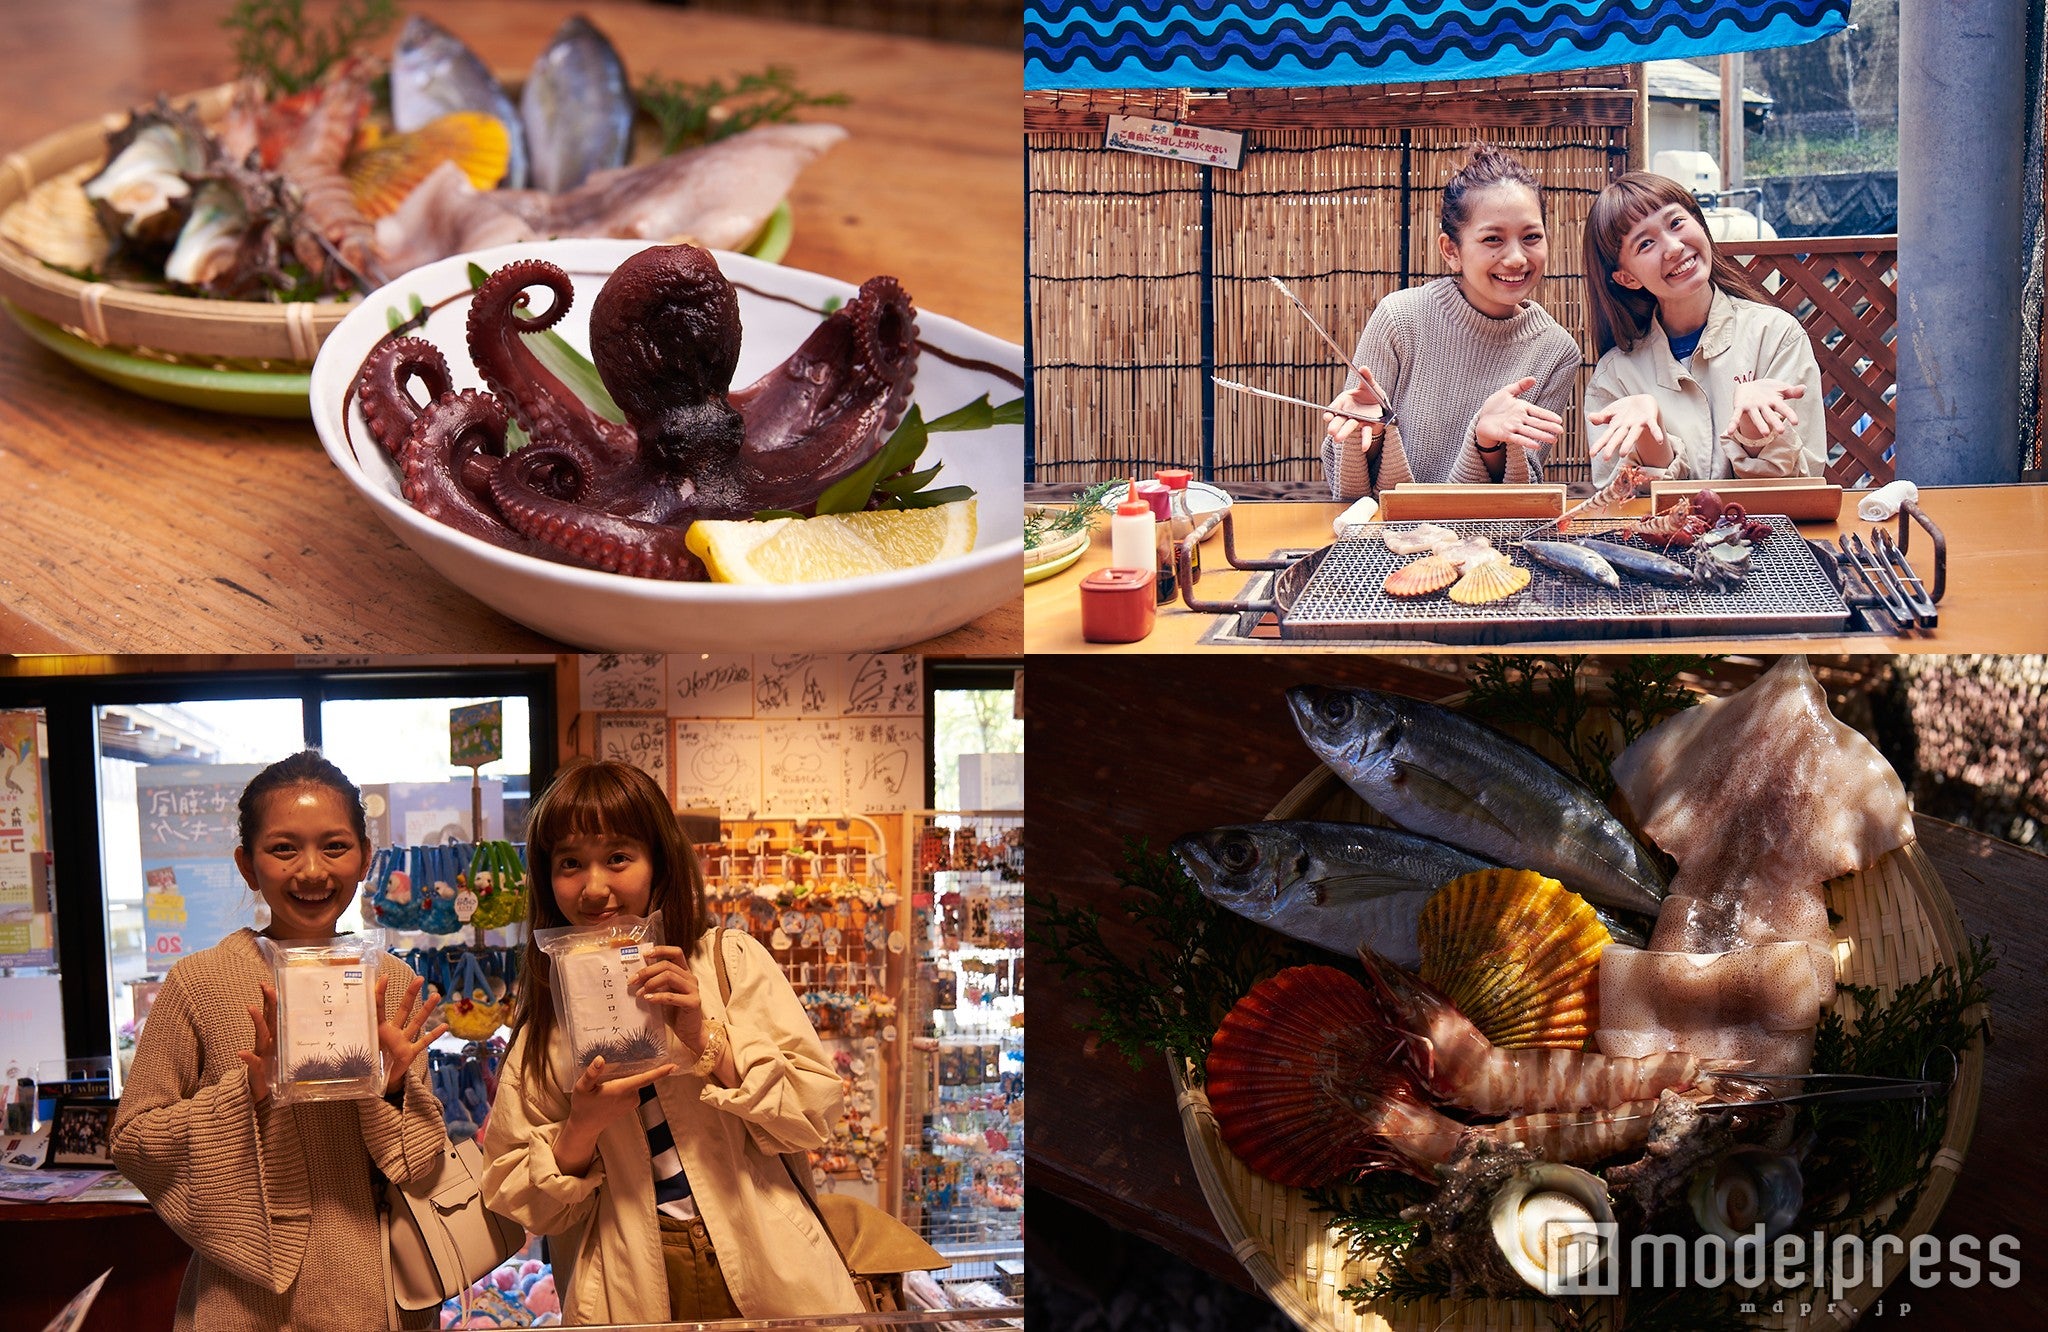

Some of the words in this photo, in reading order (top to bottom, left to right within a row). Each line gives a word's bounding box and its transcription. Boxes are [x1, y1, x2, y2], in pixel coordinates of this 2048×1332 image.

[1119, 129, 1228, 154] ご自由にお召し上がりください
[321, 980, 337, 1051] うにコロッケ
[601, 965, 621, 1035] うにコロッケ
